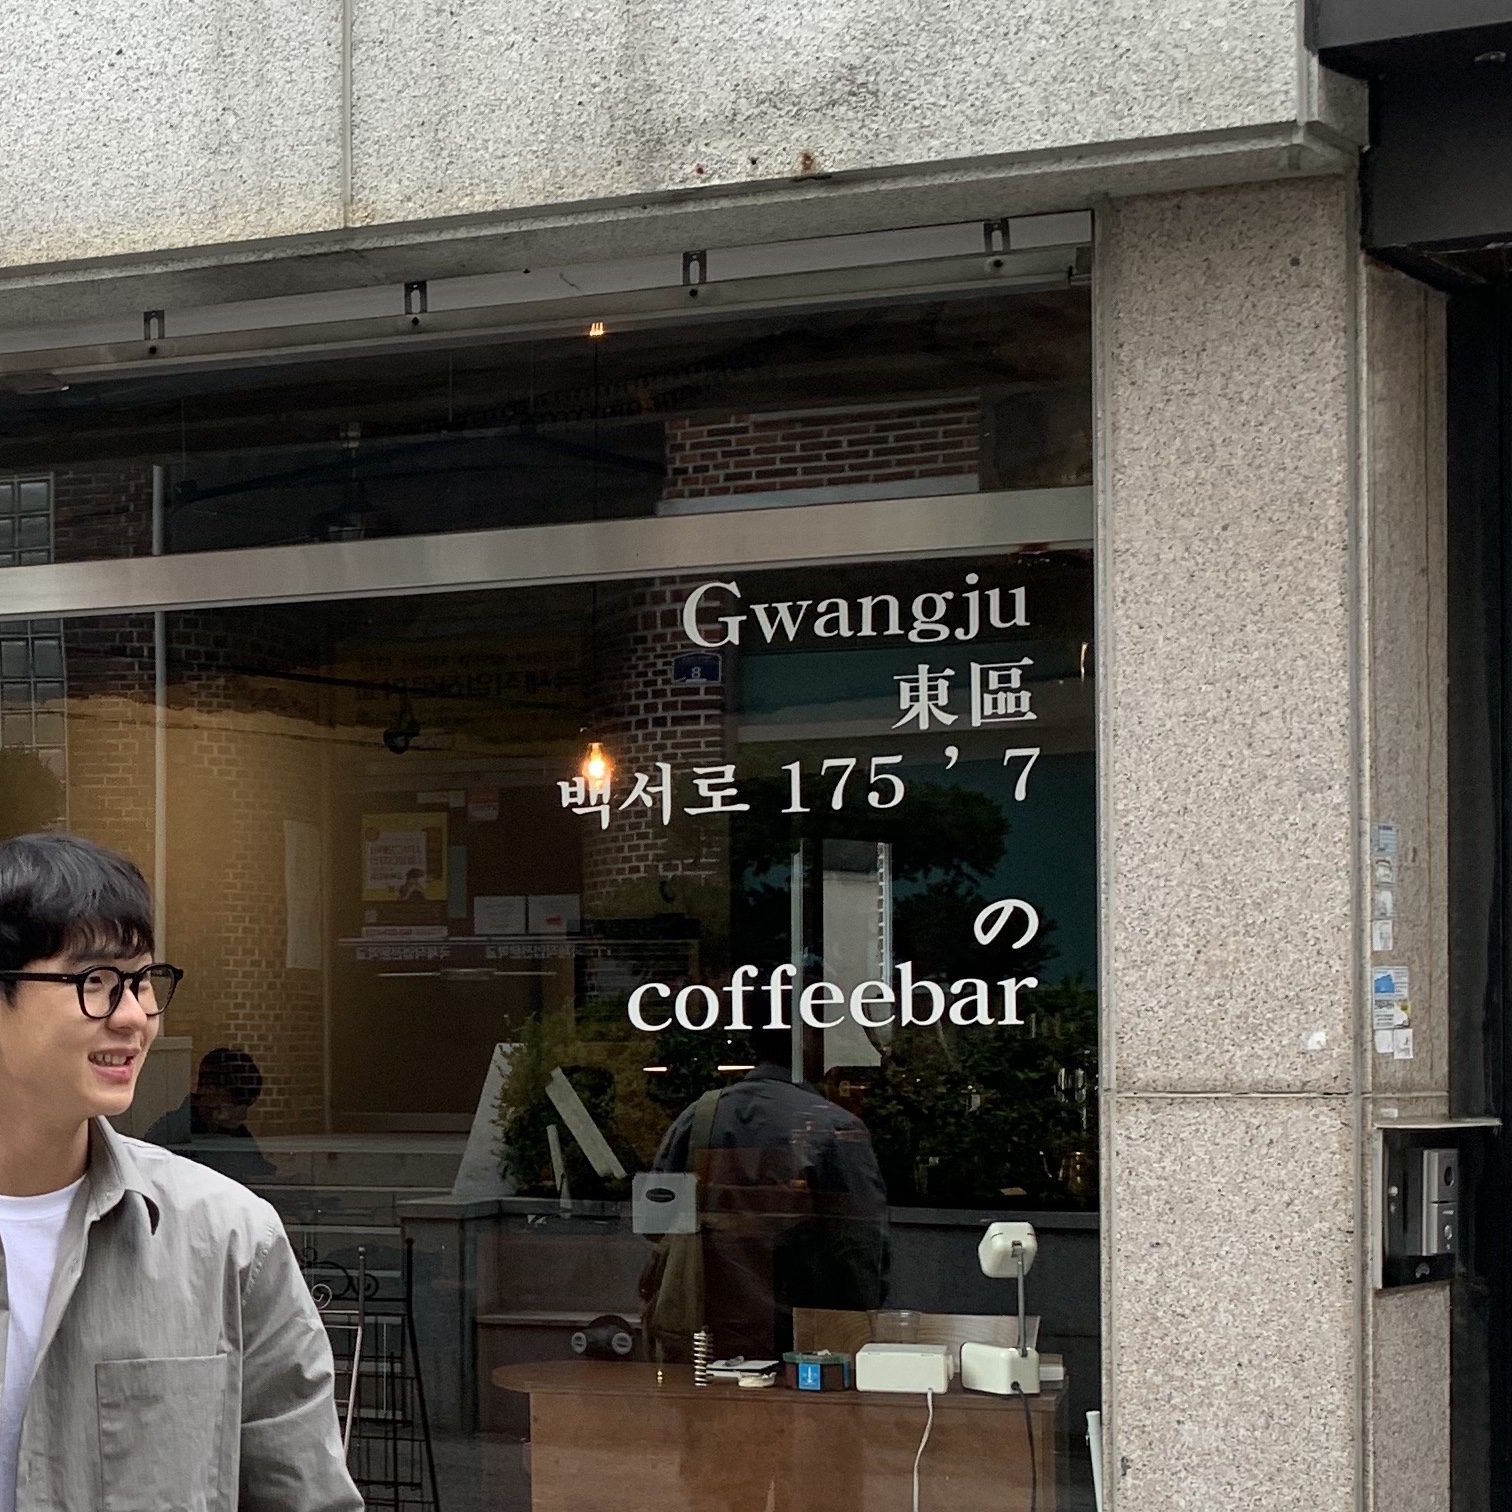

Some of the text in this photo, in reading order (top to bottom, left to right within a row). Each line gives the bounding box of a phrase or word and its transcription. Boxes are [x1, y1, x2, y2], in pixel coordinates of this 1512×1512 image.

[682, 572, 1031, 648] Gwangju
[891, 656, 1037, 730] 東區
[556, 762, 750, 830] 백서로
[781, 754, 905, 814] 175
[1003, 747, 1041, 801] 7
[973, 899, 1039, 949] の
[627, 961, 1038, 1032] coffeebar
